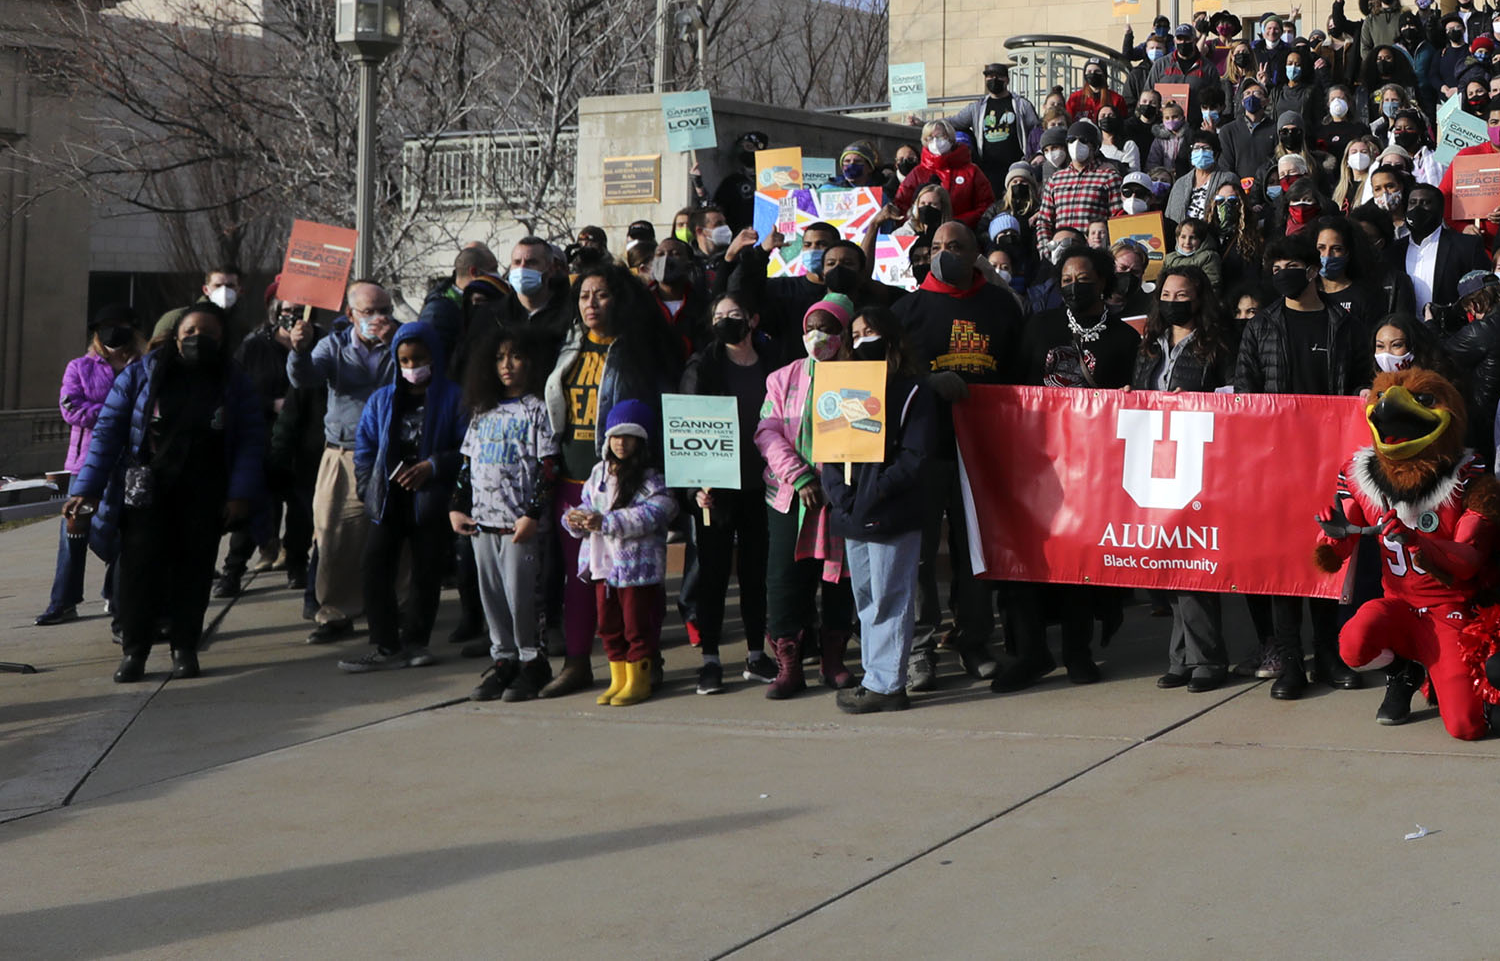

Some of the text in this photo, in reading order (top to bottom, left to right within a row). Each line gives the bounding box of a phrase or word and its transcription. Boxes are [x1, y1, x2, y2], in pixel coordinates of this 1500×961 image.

[892, 84, 924, 94] LOVE
[666, 106, 708, 117] CANNOT
[668, 117, 711, 130] LOVE
[1449, 123, 1489, 143] CANNOT
[1456, 175, 1500, 185] PEACE
[291, 248, 348, 267] PEACE
[669, 420, 734, 430] CANNOT
[669, 438, 735, 452] LOVE
[1116, 408, 1216, 510] U
[1097, 521, 1221, 551] ALUMNI
[1103, 554, 1219, 575] Black Community
